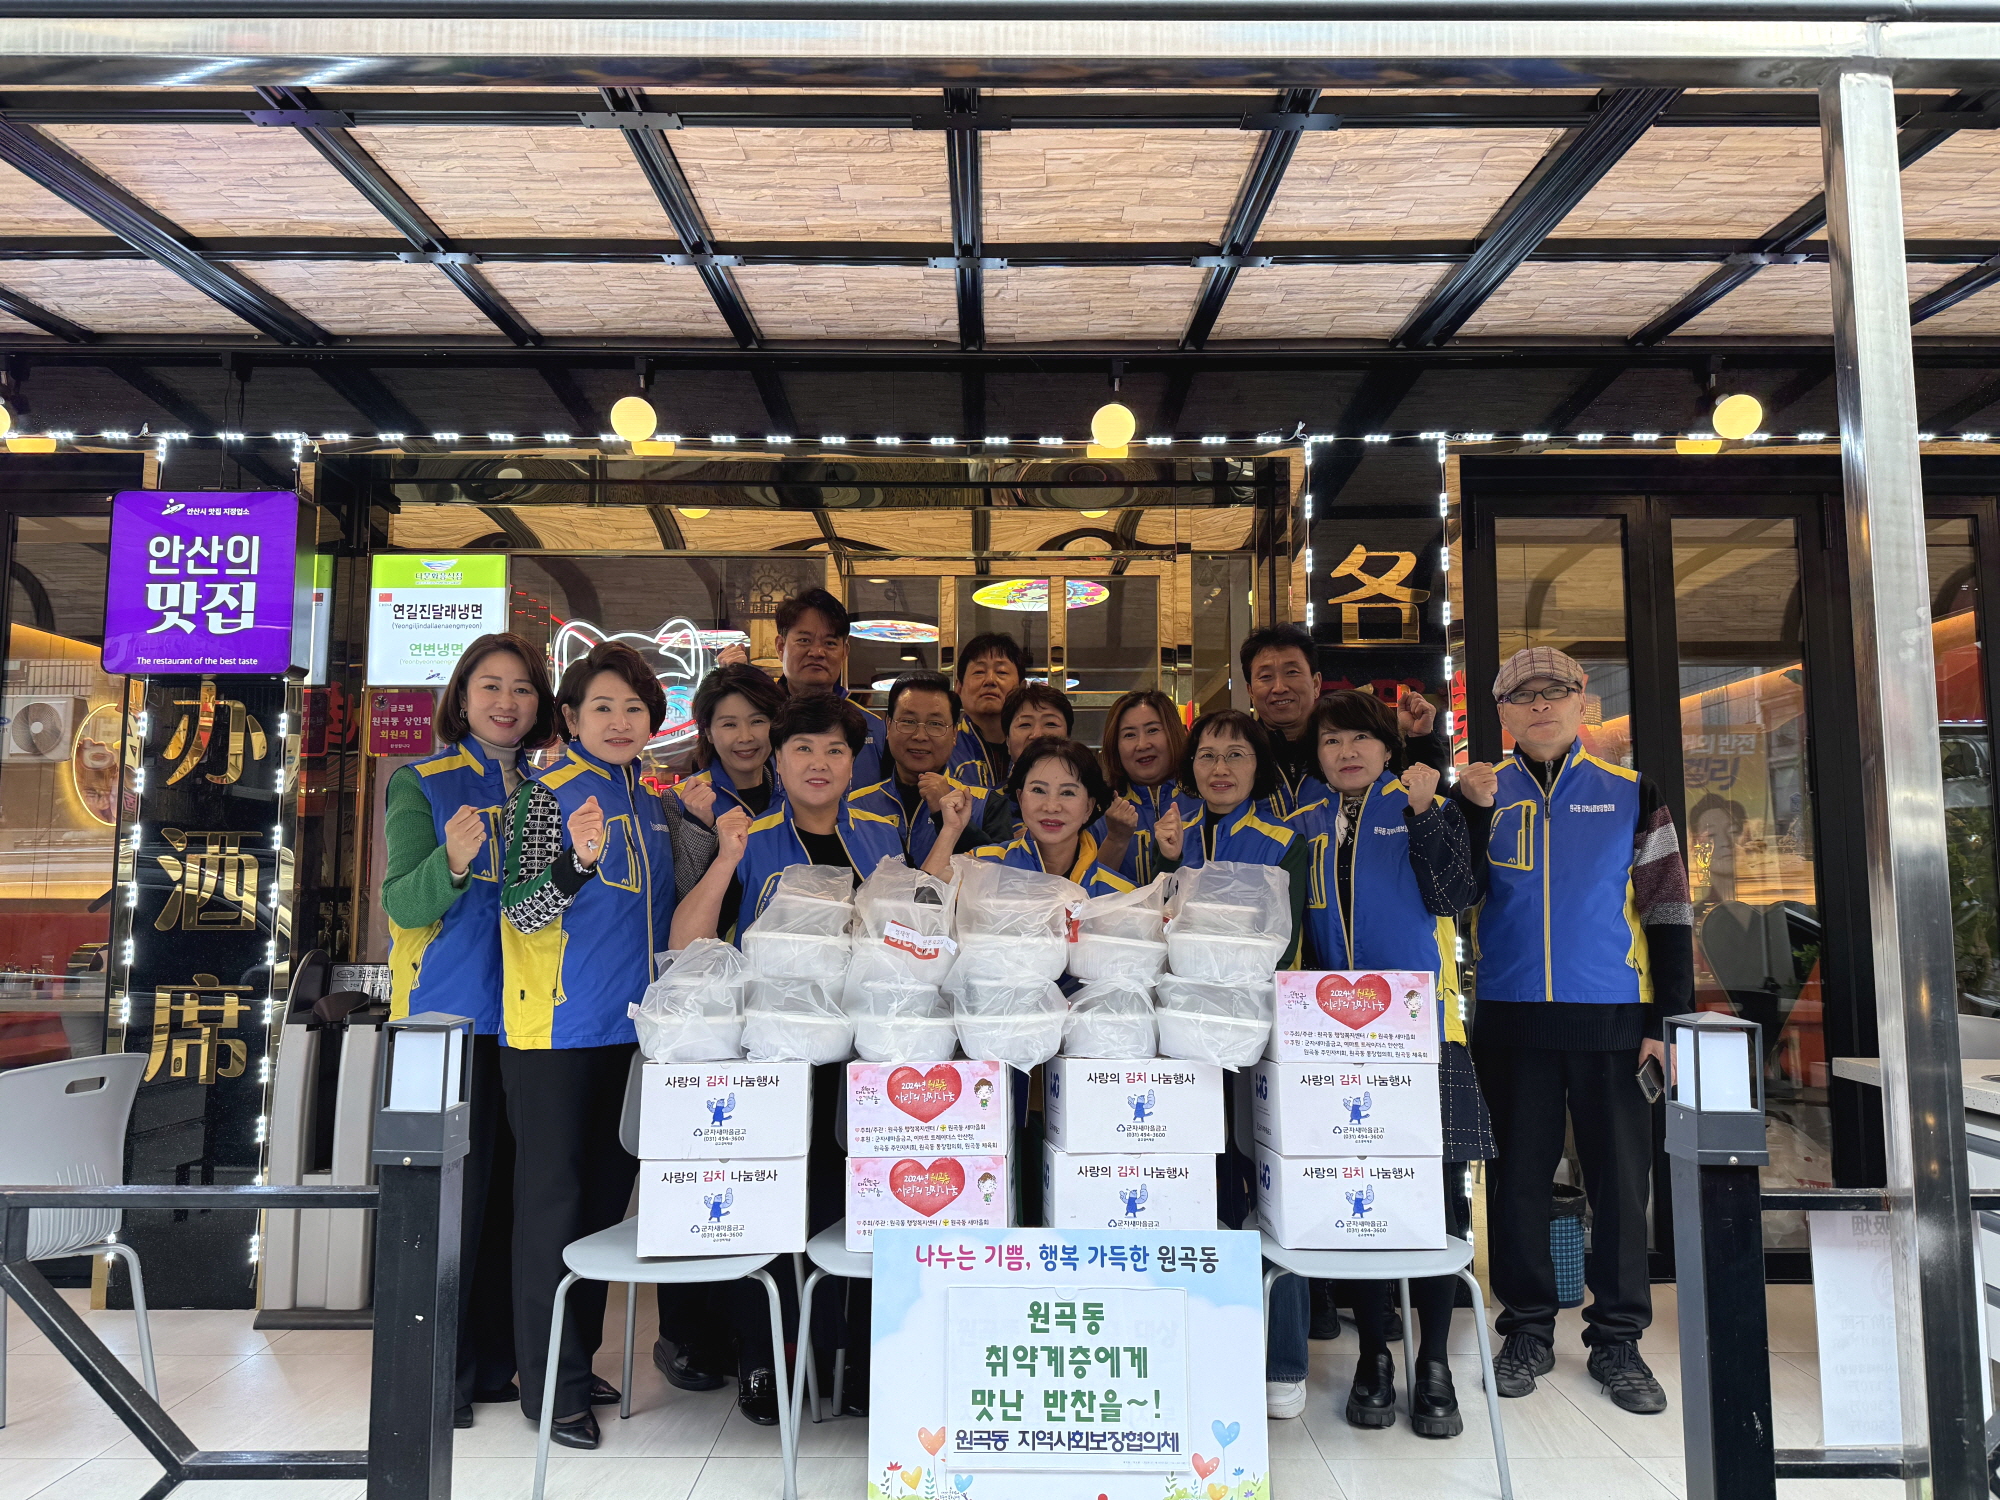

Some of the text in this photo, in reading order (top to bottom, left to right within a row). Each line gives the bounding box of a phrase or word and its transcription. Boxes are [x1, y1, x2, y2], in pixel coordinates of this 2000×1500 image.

[186, 508, 250, 516] 안산시 맛집 지정업소
[149, 535, 260, 575] 안산의
[145, 581, 257, 635] 맛집
[392, 603, 483, 620] 연길진달래냉면
[409, 642, 464, 657] 연변냉면
[137, 657, 152, 665] The
[194, 657, 204, 665] of
[204, 657, 218, 665] the
[220, 657, 236, 665] best
[390, 704, 414, 712] 글로벌
[372, 716, 431, 726] 원곡동 상인회
[380, 730, 422, 740] 회원의 집
[1330, 988, 1377, 1000] 2024년 원곡동
[1322, 1000, 1350, 1011] 사랑의
[1304, 1048, 1319, 1056] 원곡동
[665, 1075, 780, 1088] 사랑의 김치 나눔행사
[1086, 1072, 1196, 1085] 사랑의 김치 나눔행사
[1300, 1074, 1412, 1086] 사랑의 김치 나눔행사
[902, 1079, 948, 1092] 2024년 원곡동
[895, 1092, 920, 1104] 사랑의
[704, 1128, 747, 1136] 군자새마을금고
[1126, 1124, 1168, 1132] 군자새마을금고
[1342, 1126, 1385, 1134] 군자새마을금고
[874, 1144, 889, 1152] 원곡동
[964, 1142, 980, 1150] 원곡동
[661, 1170, 778, 1184] 사랑의 김치 나눔행사
[904, 1172, 950, 1185] 2024년 원곡동
[1077, 1166, 1190, 1179] 사랑의 김치 나눔행사
[1302, 1166, 1415, 1180] 사랑의 김치 나눔행사
[896, 1185, 922, 1198] 사랑의
[701, 1224, 745, 1232] 군자새마을금고
[1117, 1220, 1160, 1228] 군자새마을금고
[915, 1244, 1220, 1274] 나누는 기쁨, 행복 가득한 원곡동
[1027, 1300, 1106, 1335] 원곡동
[985, 1344, 1149, 1379] 취약계층에게
[971, 1388, 1162, 1423] 맛난 반찬을~!
[954, 1430, 1180, 1453] 원곡동 지역사회보장협의체
